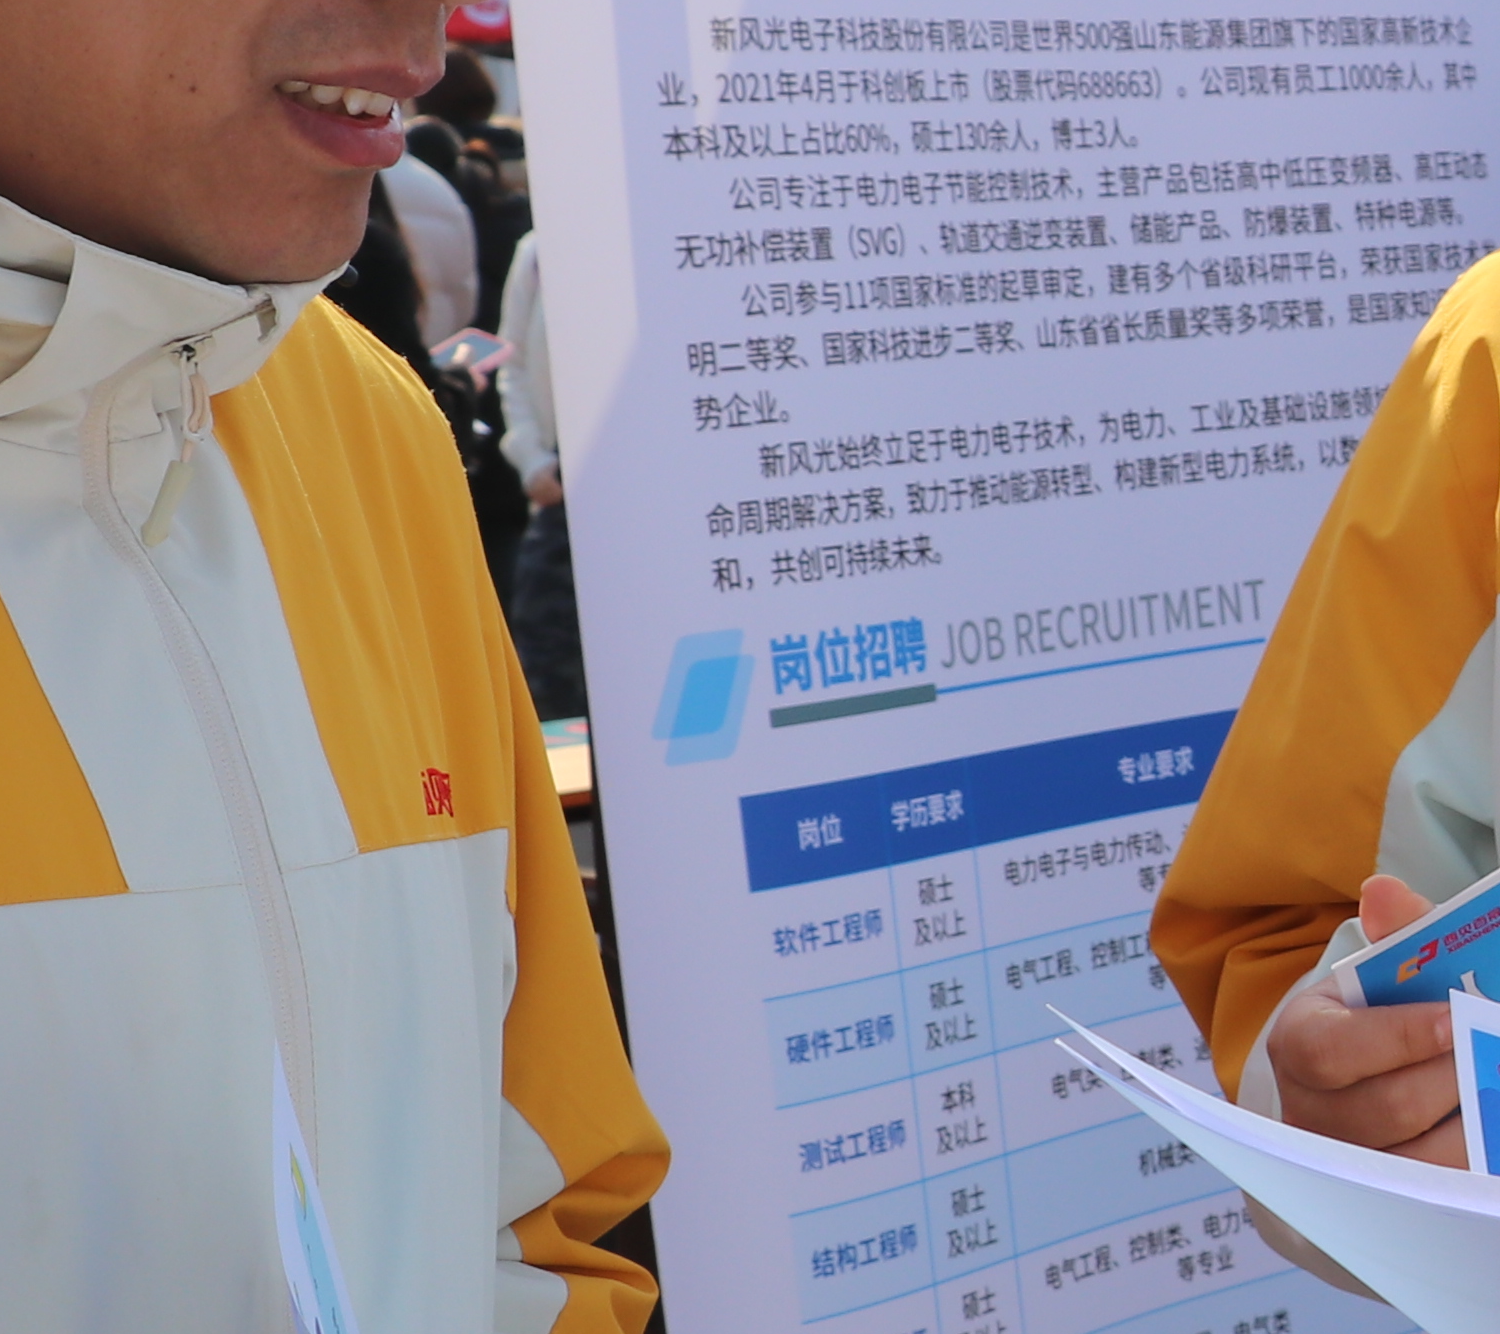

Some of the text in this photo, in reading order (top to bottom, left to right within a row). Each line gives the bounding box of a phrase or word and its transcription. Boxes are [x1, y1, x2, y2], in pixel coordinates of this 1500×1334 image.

[770, 578, 1265, 695] 岗位招聘 JOB RECRUITMENT
[797, 746, 1195, 851] 岗位 学历要求 专业要求
[917, 873, 955, 906] 硕士
[773, 909, 883, 958] 软件工程师
[913, 908, 967, 947] 及以上
[928, 978, 966, 1012] 硕士
[786, 1013, 895, 1066] 硬件工程师
[924, 1012, 977, 1051] 及以上
[940, 1079, 976, 1115] 本科
[799, 1120, 906, 1173] 测试工程师
[935, 1117, 989, 1157] 及以上
[950, 1186, 987, 1218] 硕士
[810, 1222, 919, 1280] 结构工程师
[946, 1220, 999, 1259] 及以上
[961, 1286, 997, 1318] 硕士
